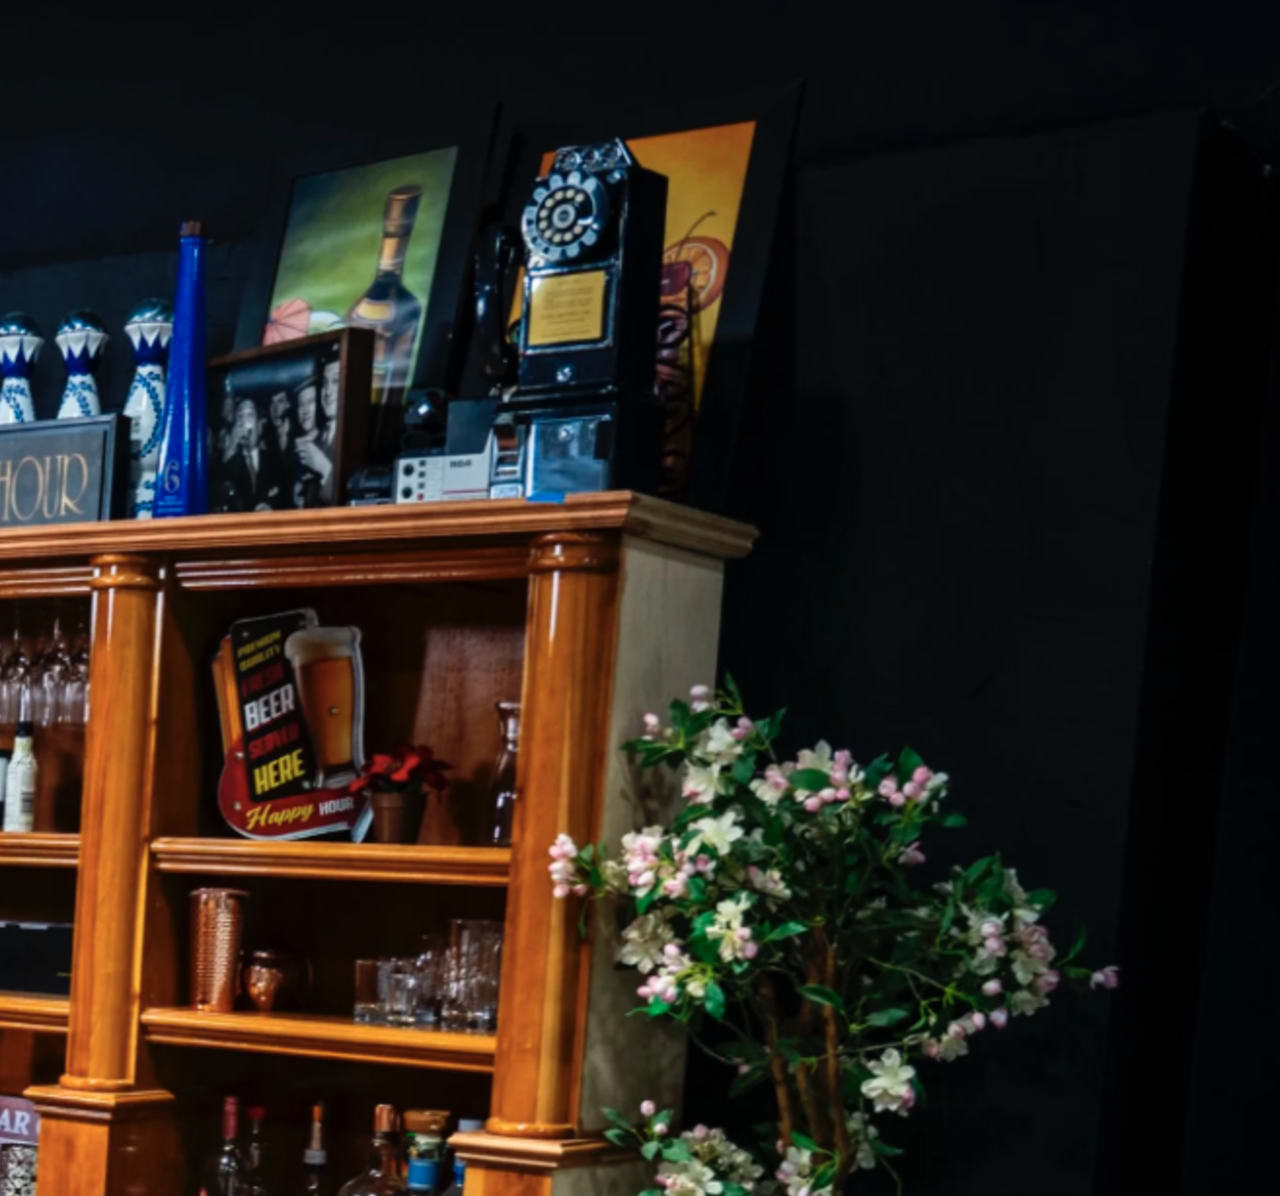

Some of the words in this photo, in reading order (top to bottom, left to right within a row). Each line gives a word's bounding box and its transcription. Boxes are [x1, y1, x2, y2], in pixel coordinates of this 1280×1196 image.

[244, 683, 295, 732] BEER
[254, 748, 306, 796] HERE
[246, 803, 314, 830] Happy
